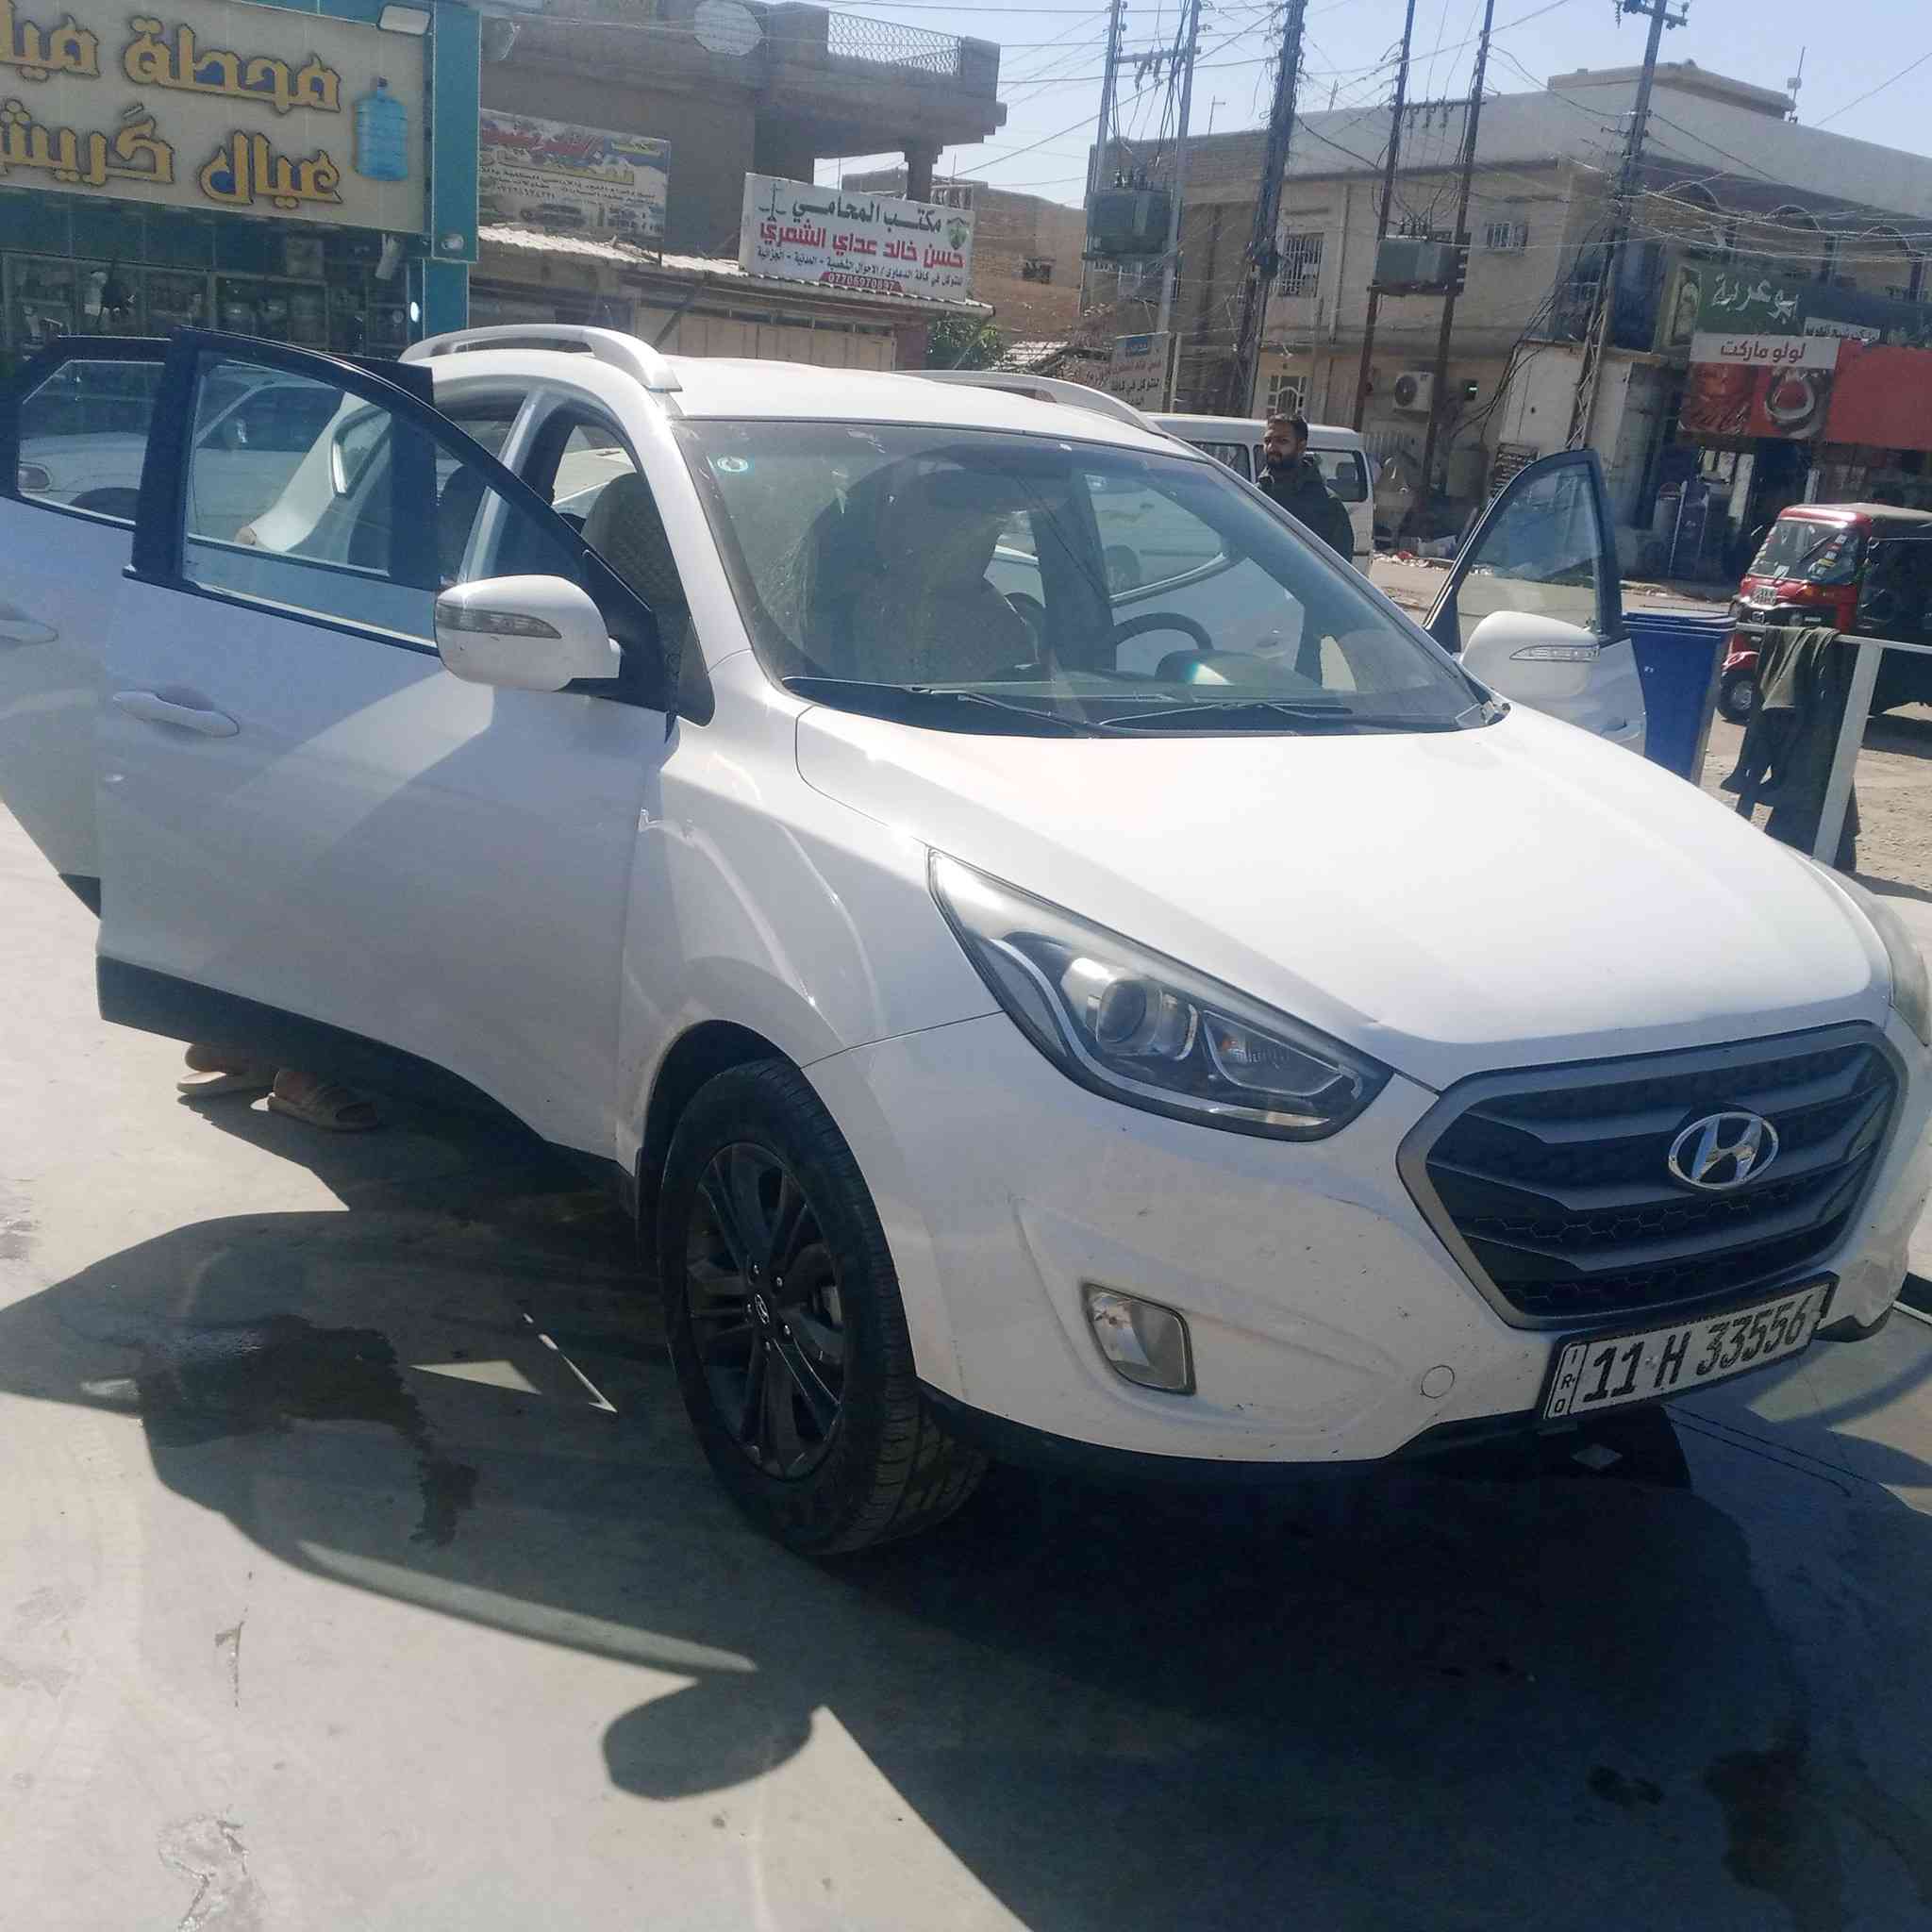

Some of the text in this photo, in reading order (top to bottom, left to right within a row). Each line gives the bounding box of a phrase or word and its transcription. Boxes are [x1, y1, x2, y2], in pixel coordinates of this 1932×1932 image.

[0, 0, 341, 114] محطة ميا
[198, 129, 344, 209] عيال
[791, 195, 942, 233] مكتب المحامي
[832, 232, 878, 257] عداي
[882, 239, 918, 262] خالد
[923, 242, 964, 269] حسن
[1720, 341, 1807, 363] لولو ماركت
[1583, 1294, 1815, 1403] 11 H 33556
